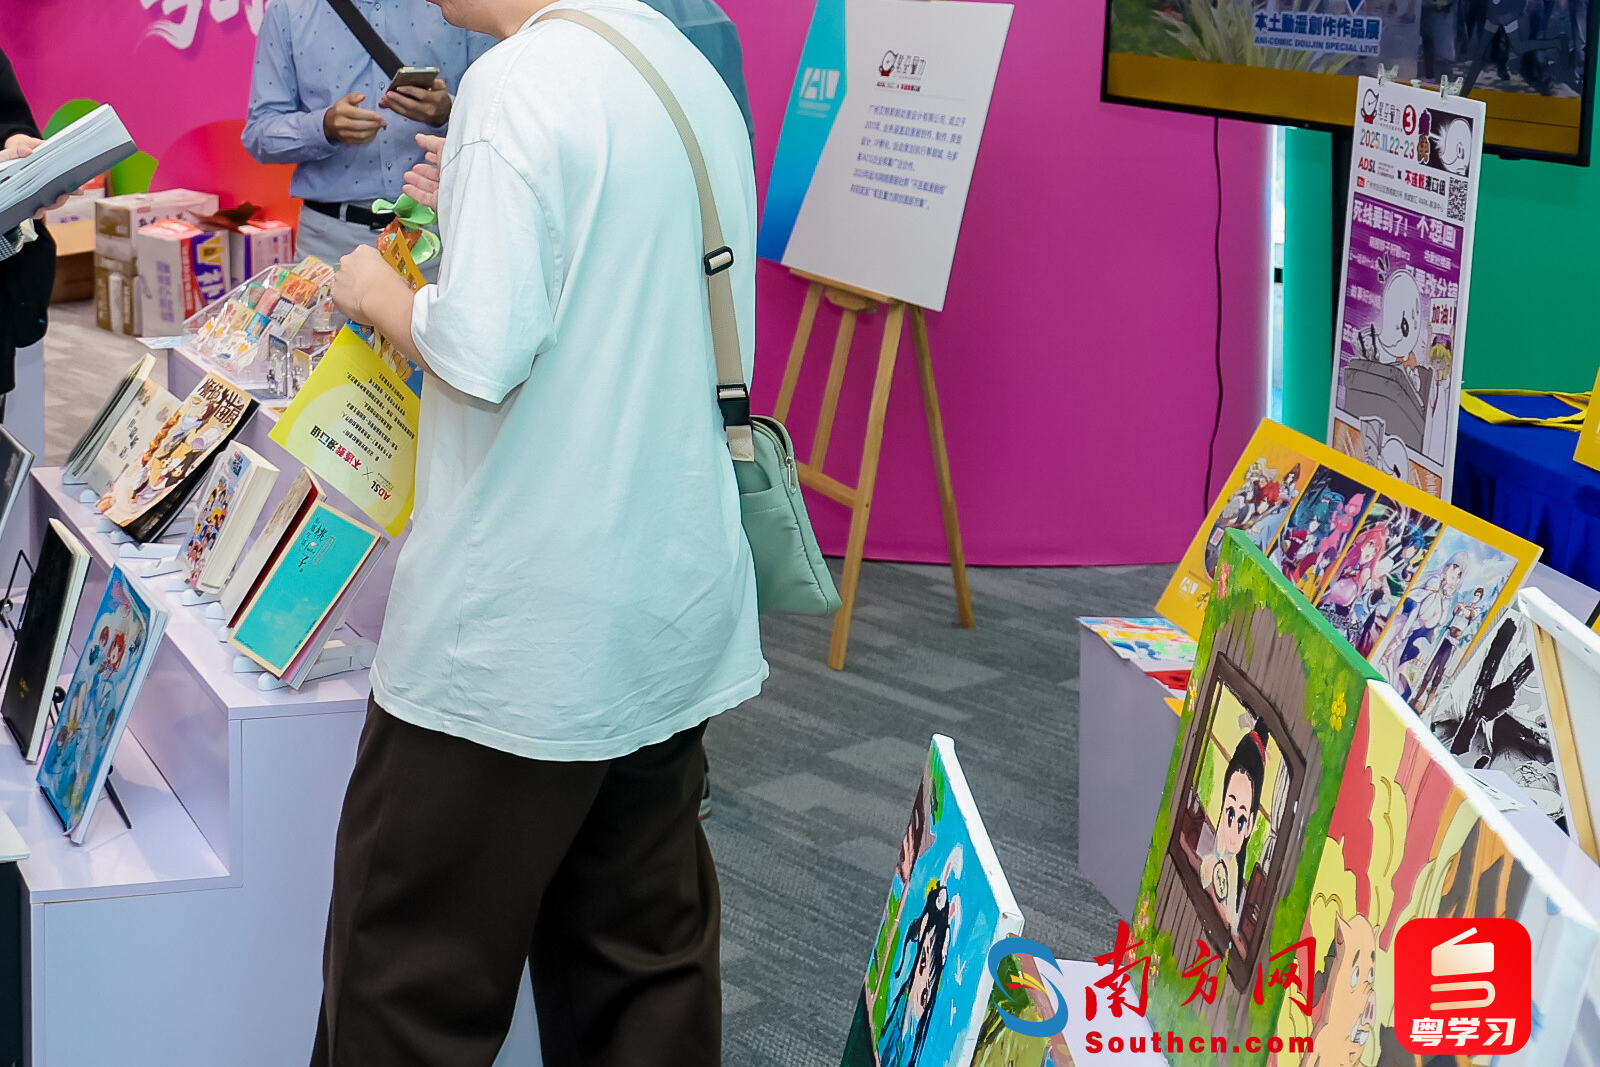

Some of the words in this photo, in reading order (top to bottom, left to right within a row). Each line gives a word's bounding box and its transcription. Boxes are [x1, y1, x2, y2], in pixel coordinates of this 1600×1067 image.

[1326, 40, 1359, 54] SPECIAL
[1361, 43, 1380, 55] LIVE
[1357, 156, 1377, 175] ADSL
[370, 480, 392, 501] ADSL
